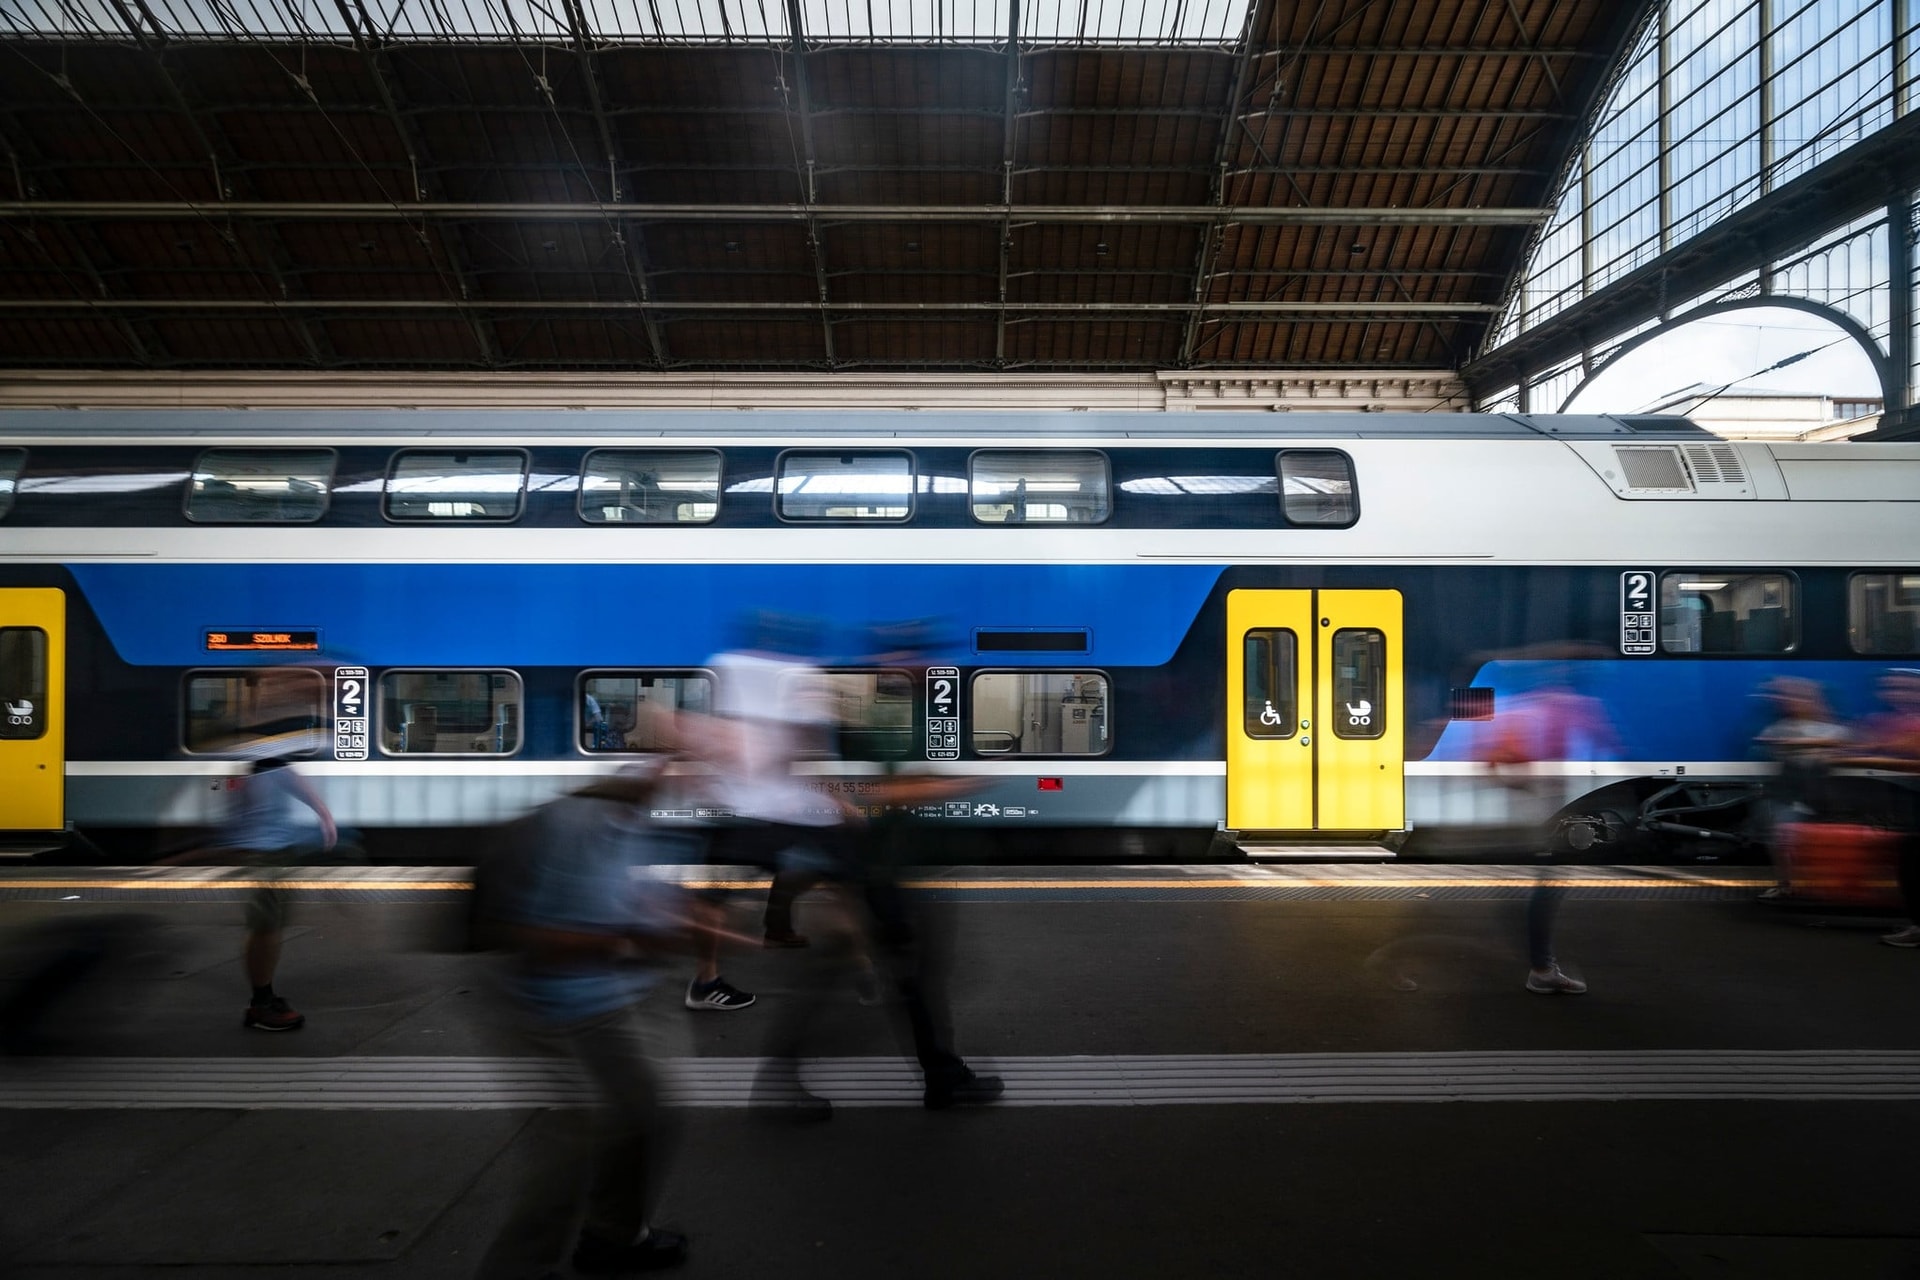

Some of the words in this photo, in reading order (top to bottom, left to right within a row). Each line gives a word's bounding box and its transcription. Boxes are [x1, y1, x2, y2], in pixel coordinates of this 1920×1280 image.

[1628, 574, 1649, 599] 2
[341, 680, 361, 704] 2
[934, 680, 952, 704] 2
[827, 782, 840, 793] 94
[843, 782, 856, 793] 55
